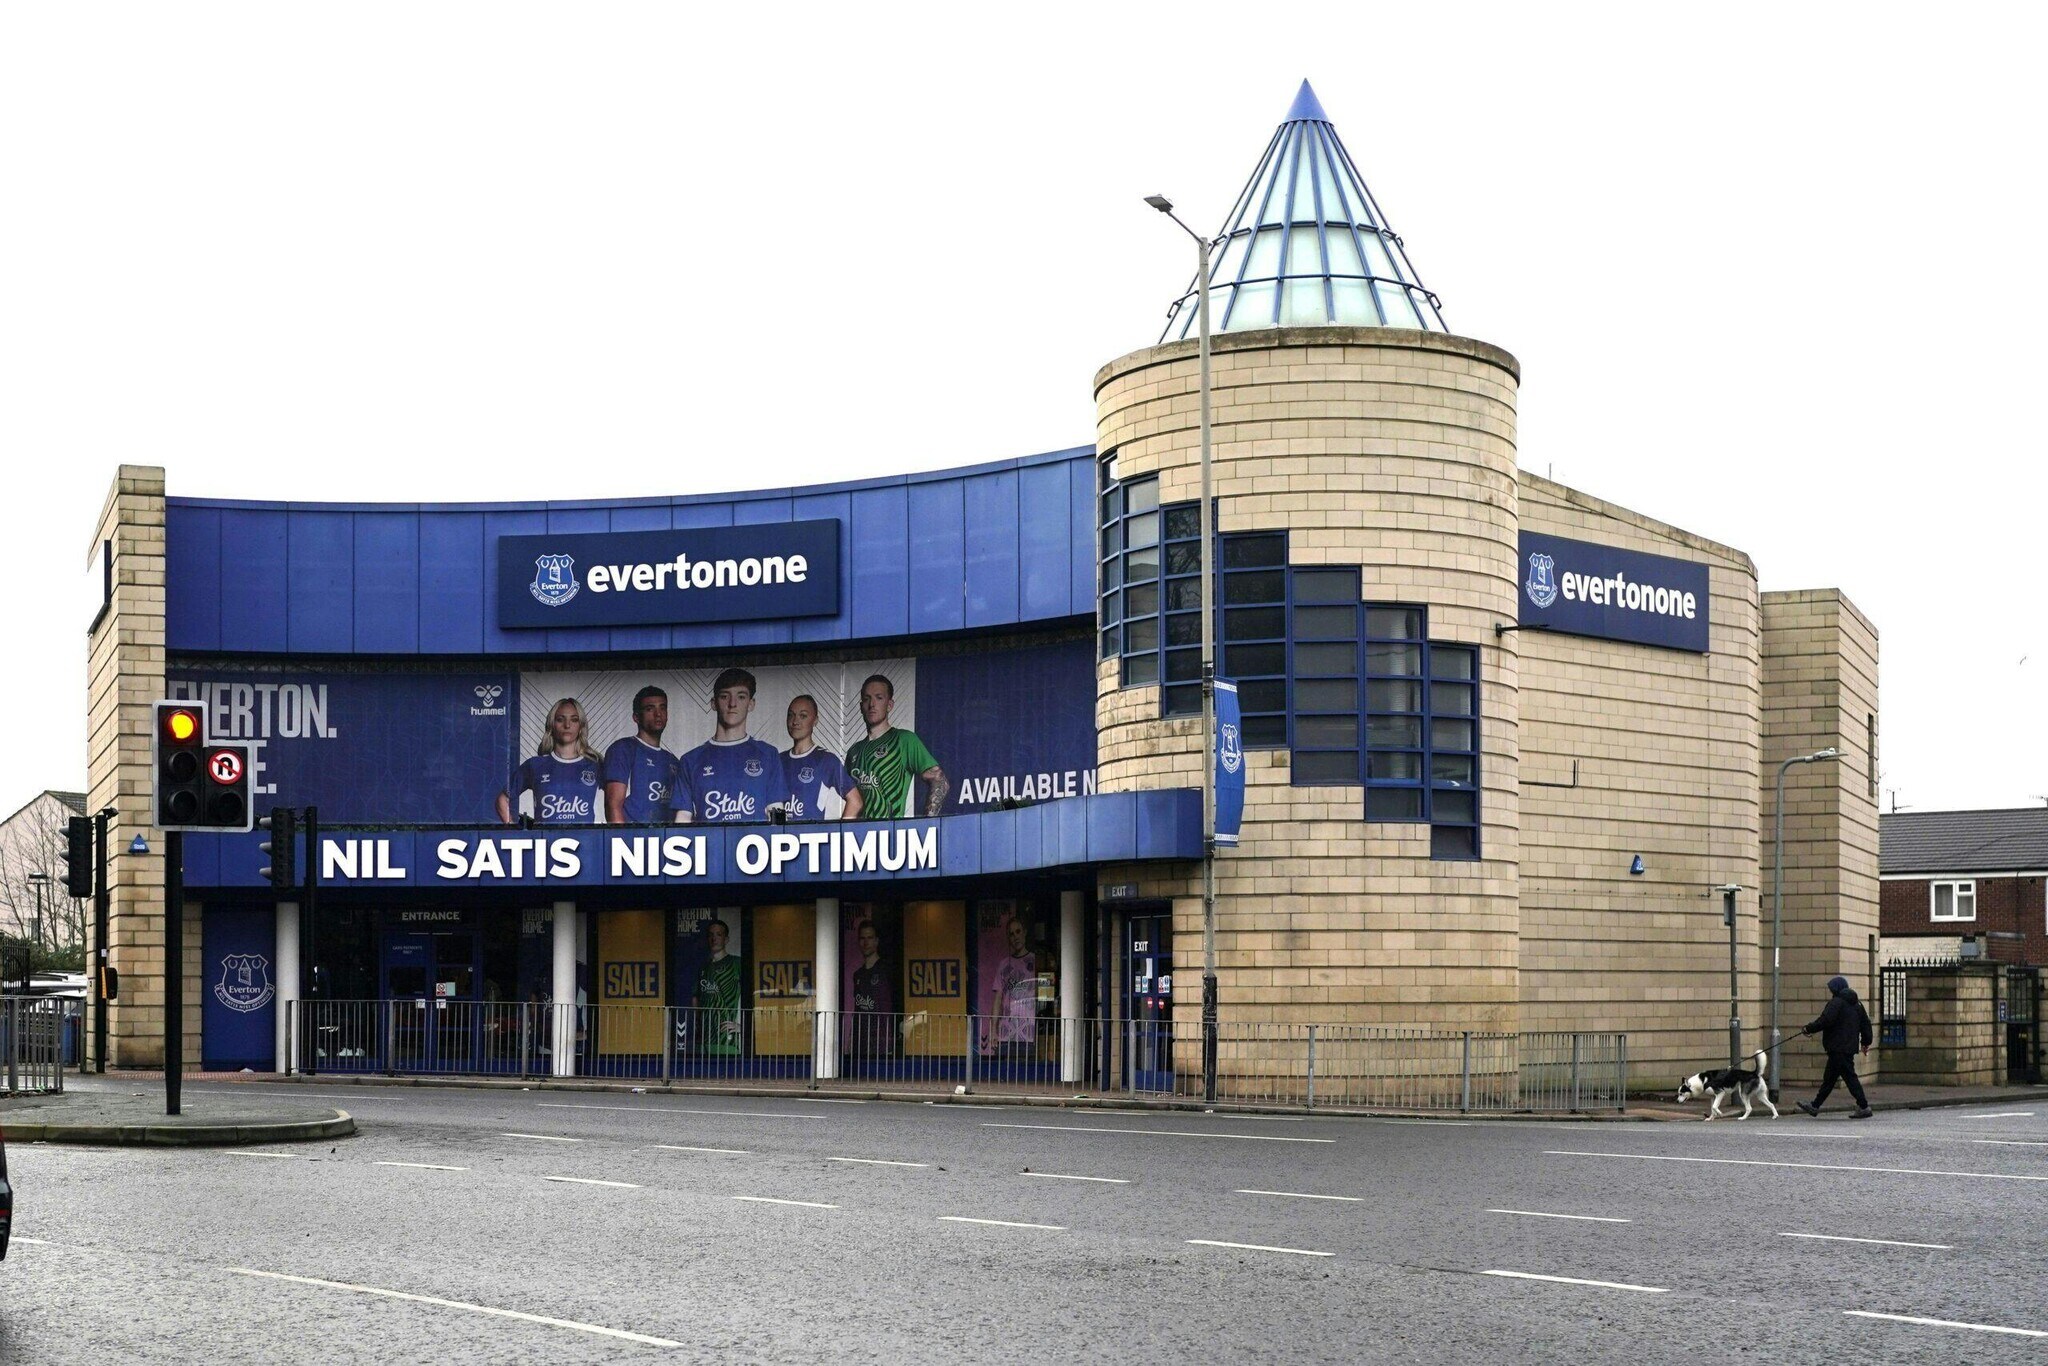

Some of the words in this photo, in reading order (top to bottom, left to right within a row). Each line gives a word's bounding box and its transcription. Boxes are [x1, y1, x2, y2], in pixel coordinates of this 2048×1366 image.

[587, 552, 809, 593] evertonone
[541, 582, 568, 590] Everton
[1561, 571, 1696, 619] evertonone
[470, 706, 506, 716] hummel
[850, 768, 880, 788] Stake
[958, 770, 1077, 804] AVAILABLE
[540, 794, 590, 818] Stake
[704, 790, 755, 820] Stake
[722, 813, 742, 821] .com
[322, 839, 407, 879] NIL
[436, 837, 582, 879] SATIS
[611, 835, 707, 877] NISI
[735, 826, 938, 875] OPTIMUM
[1111, 885, 1127, 897] EXIT
[401, 911, 460, 921] ENTRANCE
[677, 920, 700, 933] HOME.
[1134, 941, 1149, 951] EXIT
[229, 985, 261, 993] Everton
[607, 963, 656, 996] SALE
[762, 963, 809, 996] SALE
[911, 961, 957, 995] SALE
